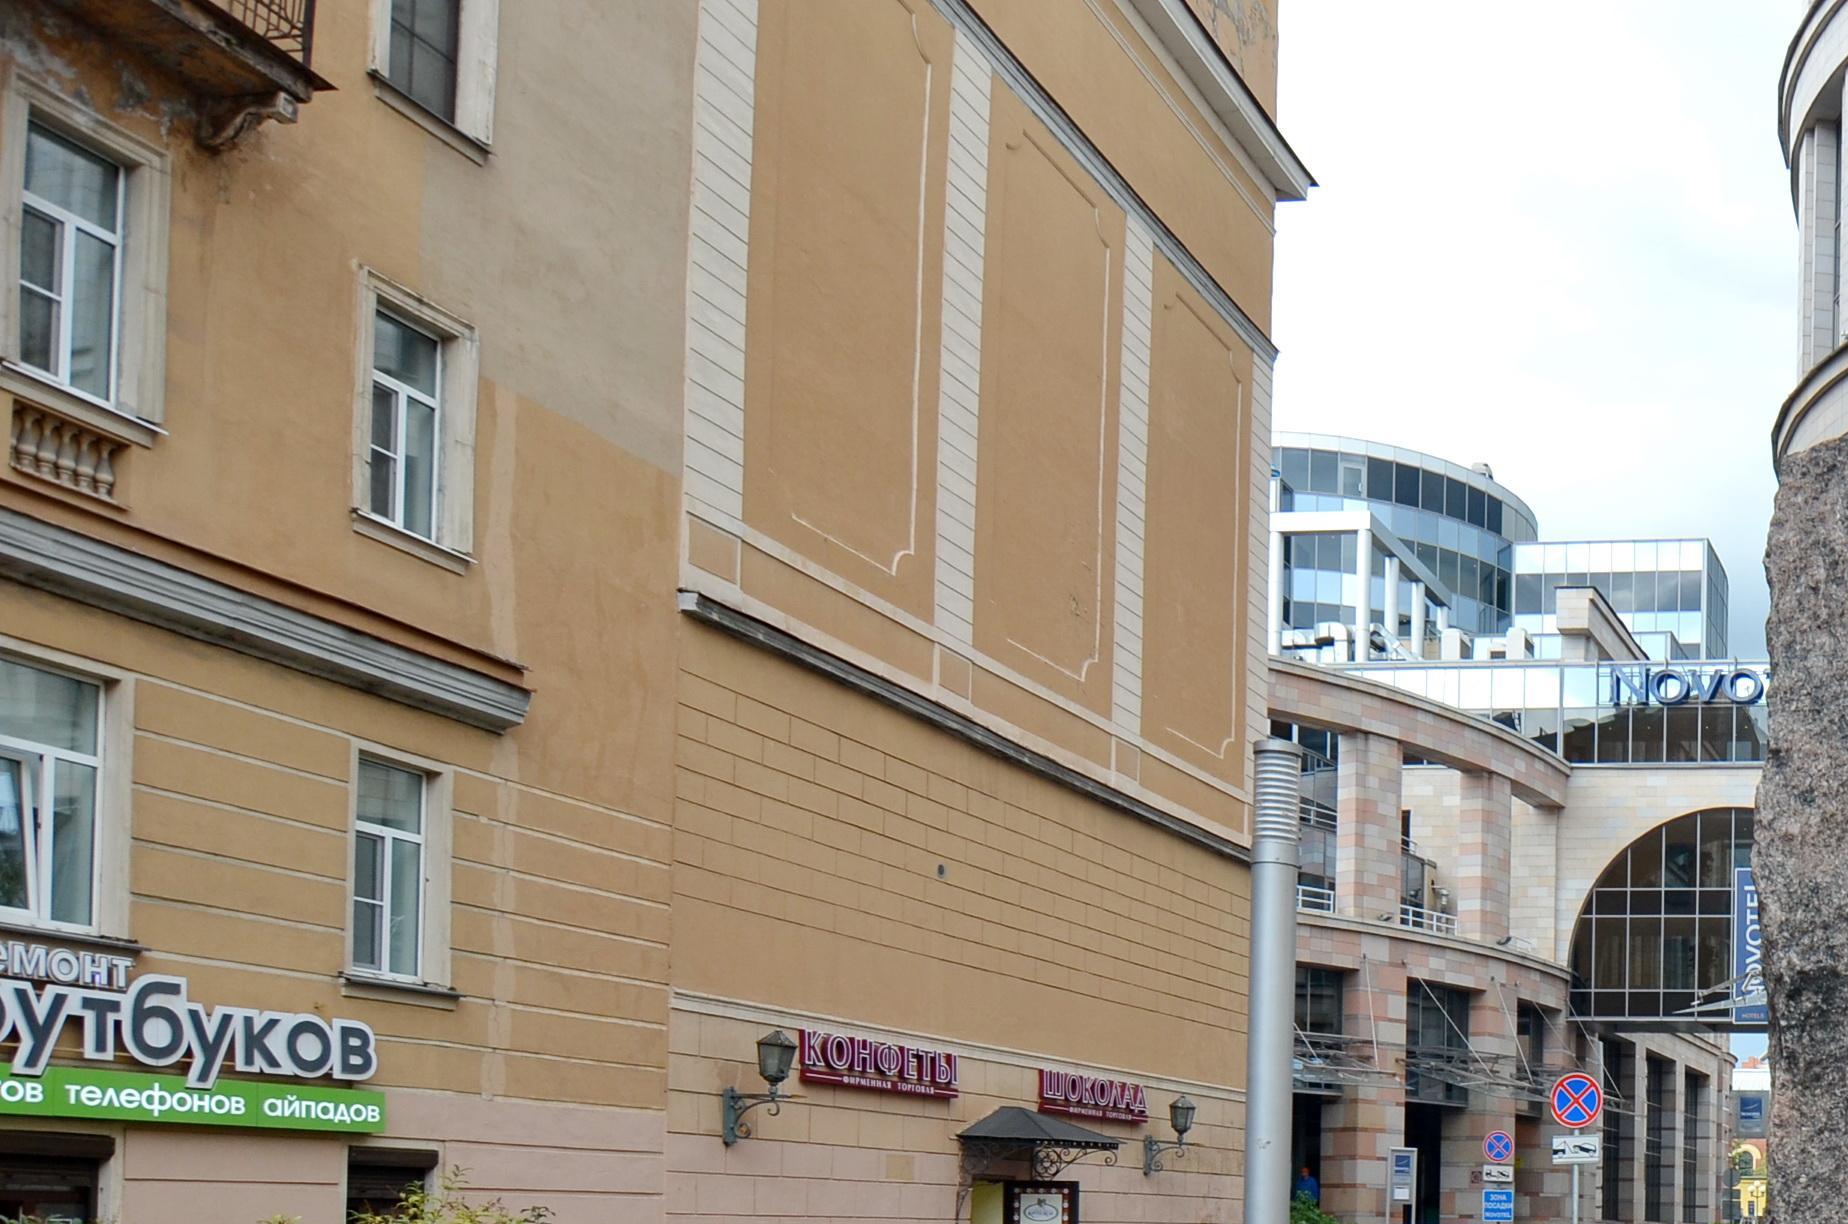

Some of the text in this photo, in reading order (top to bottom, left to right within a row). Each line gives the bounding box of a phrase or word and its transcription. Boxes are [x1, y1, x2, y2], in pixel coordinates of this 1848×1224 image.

[1610, 664, 1771, 706] NOVO
[0, 976, 376, 1086] утбуков
[804, 1029, 959, 1085] КОНФЕТЫ
[0, 1079, 381, 1123] ов телефонов айпадов
[842, 1076, 935, 1095] ФИРМЕННАЯ ТОРГОВАЯ
[1043, 1069, 1148, 1113] ШОКОЛАД
